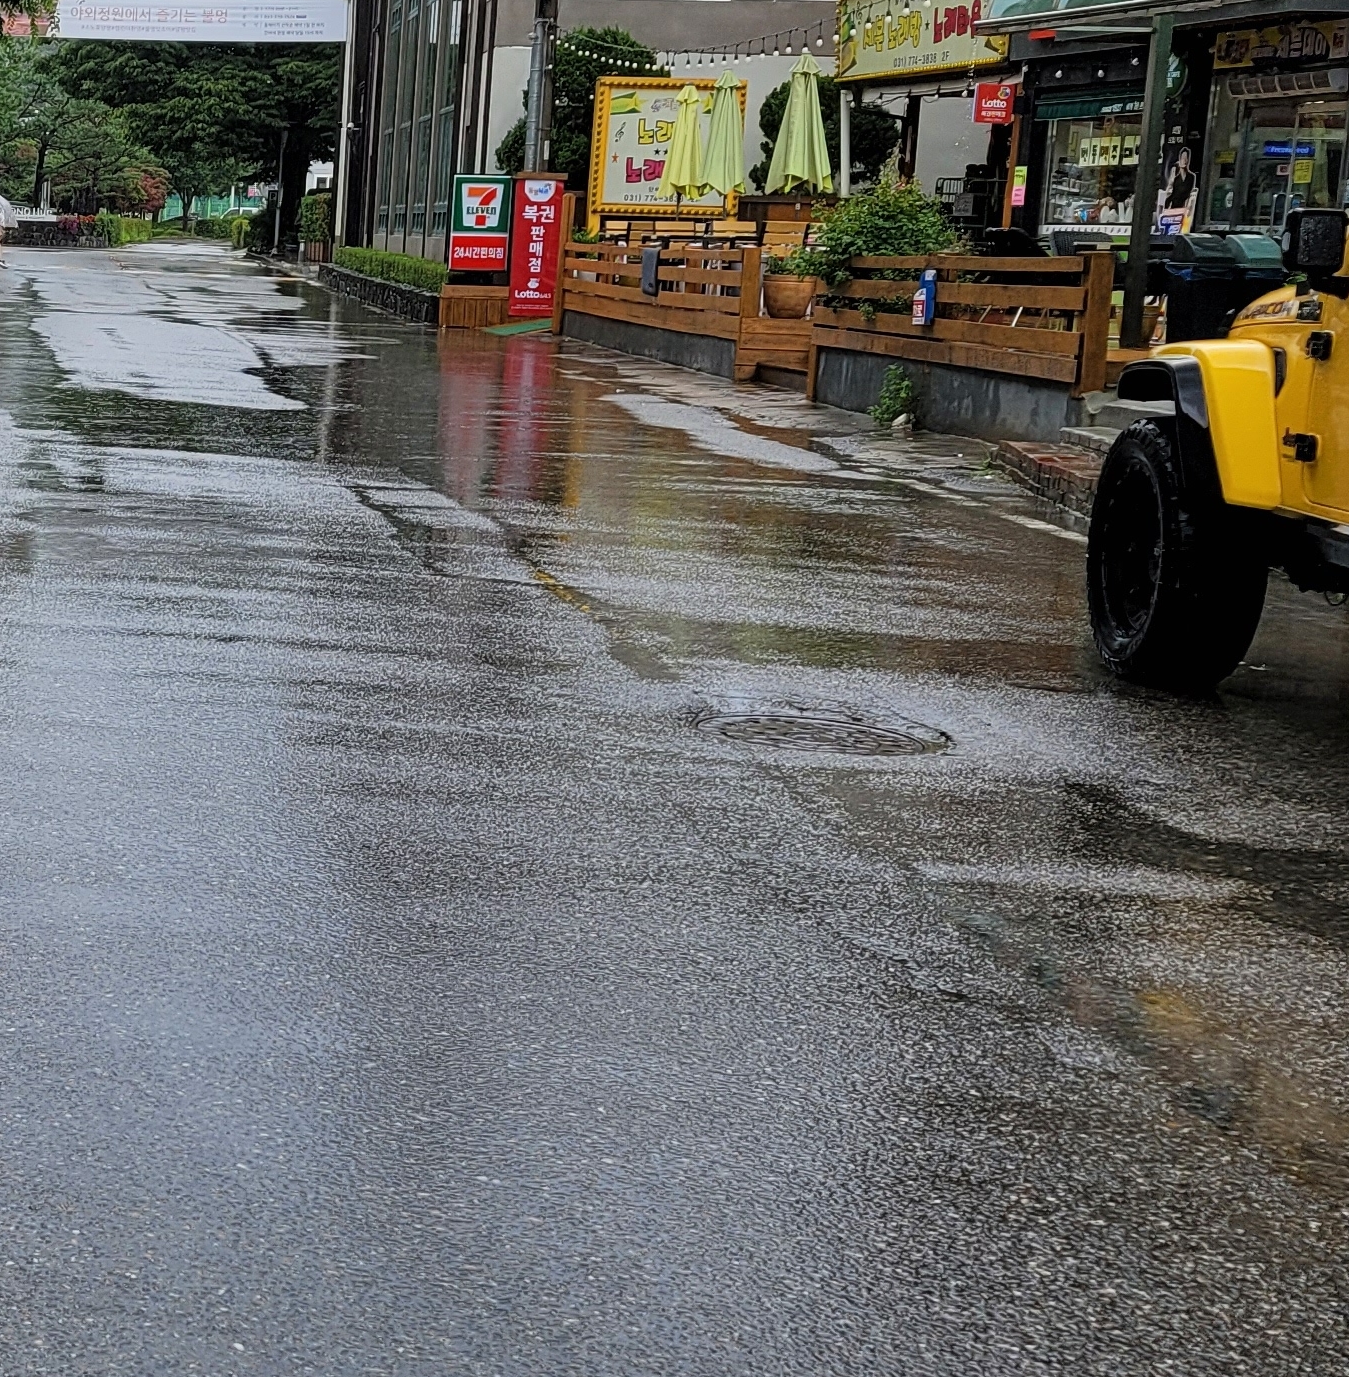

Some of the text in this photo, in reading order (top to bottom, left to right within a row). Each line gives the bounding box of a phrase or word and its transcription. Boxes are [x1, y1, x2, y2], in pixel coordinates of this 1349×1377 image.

[70, 6, 150, 22] 야외정원에서
[155, 8, 197, 23] 즐기는
[888, 11, 922, 50] 노래방
[981, 99, 1007, 109] Lotto
[467, 186, 498, 228] 7
[522, 205, 554, 223] 복권
[454, 246, 504, 259] 24시간편의점
[528, 226, 546, 273] 판매점
[514, 290, 539, 299] Lotto
